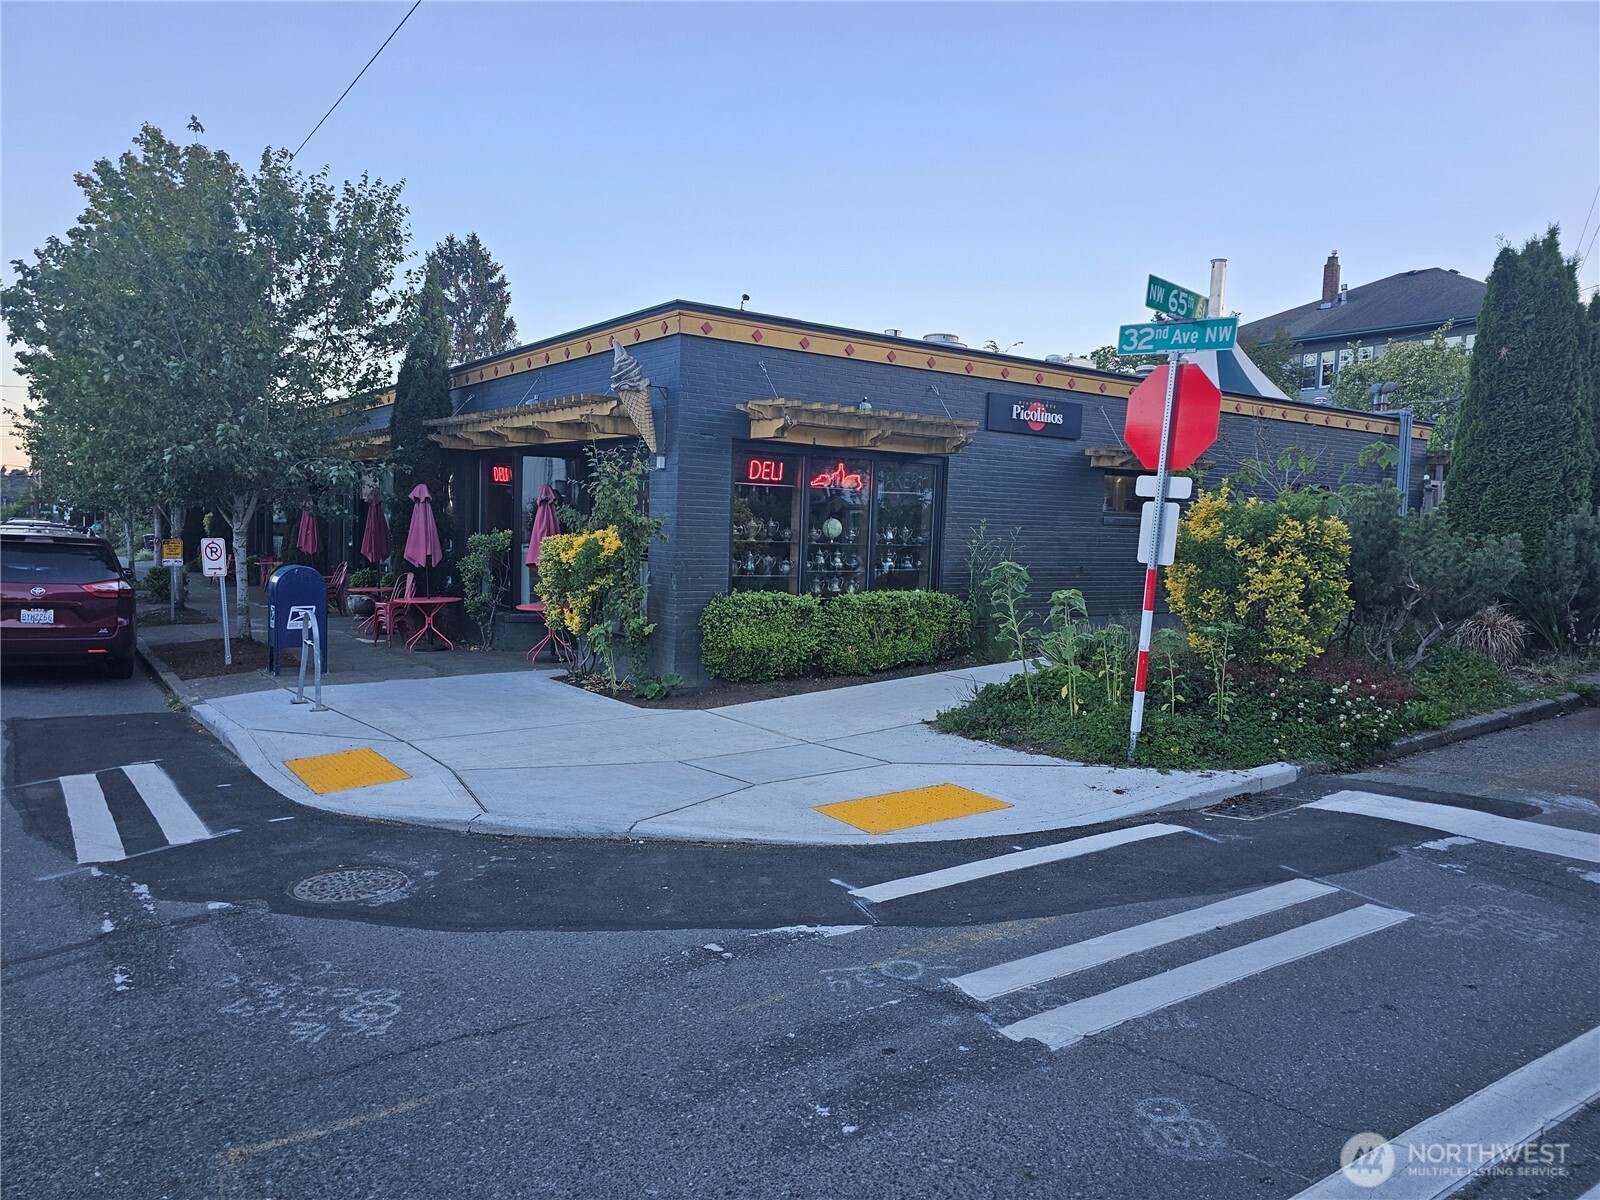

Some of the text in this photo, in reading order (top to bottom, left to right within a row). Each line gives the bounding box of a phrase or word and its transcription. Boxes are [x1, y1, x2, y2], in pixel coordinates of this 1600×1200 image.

[1149, 284, 1166, 304] NW
[1168, 289, 1195, 316] 65th
[1122, 325, 1233, 352] 32nd Ave NW
[1012, 404, 1063, 425] Picolinos
[493, 466, 510, 482] DELI
[749, 459, 784, 482] DELI
